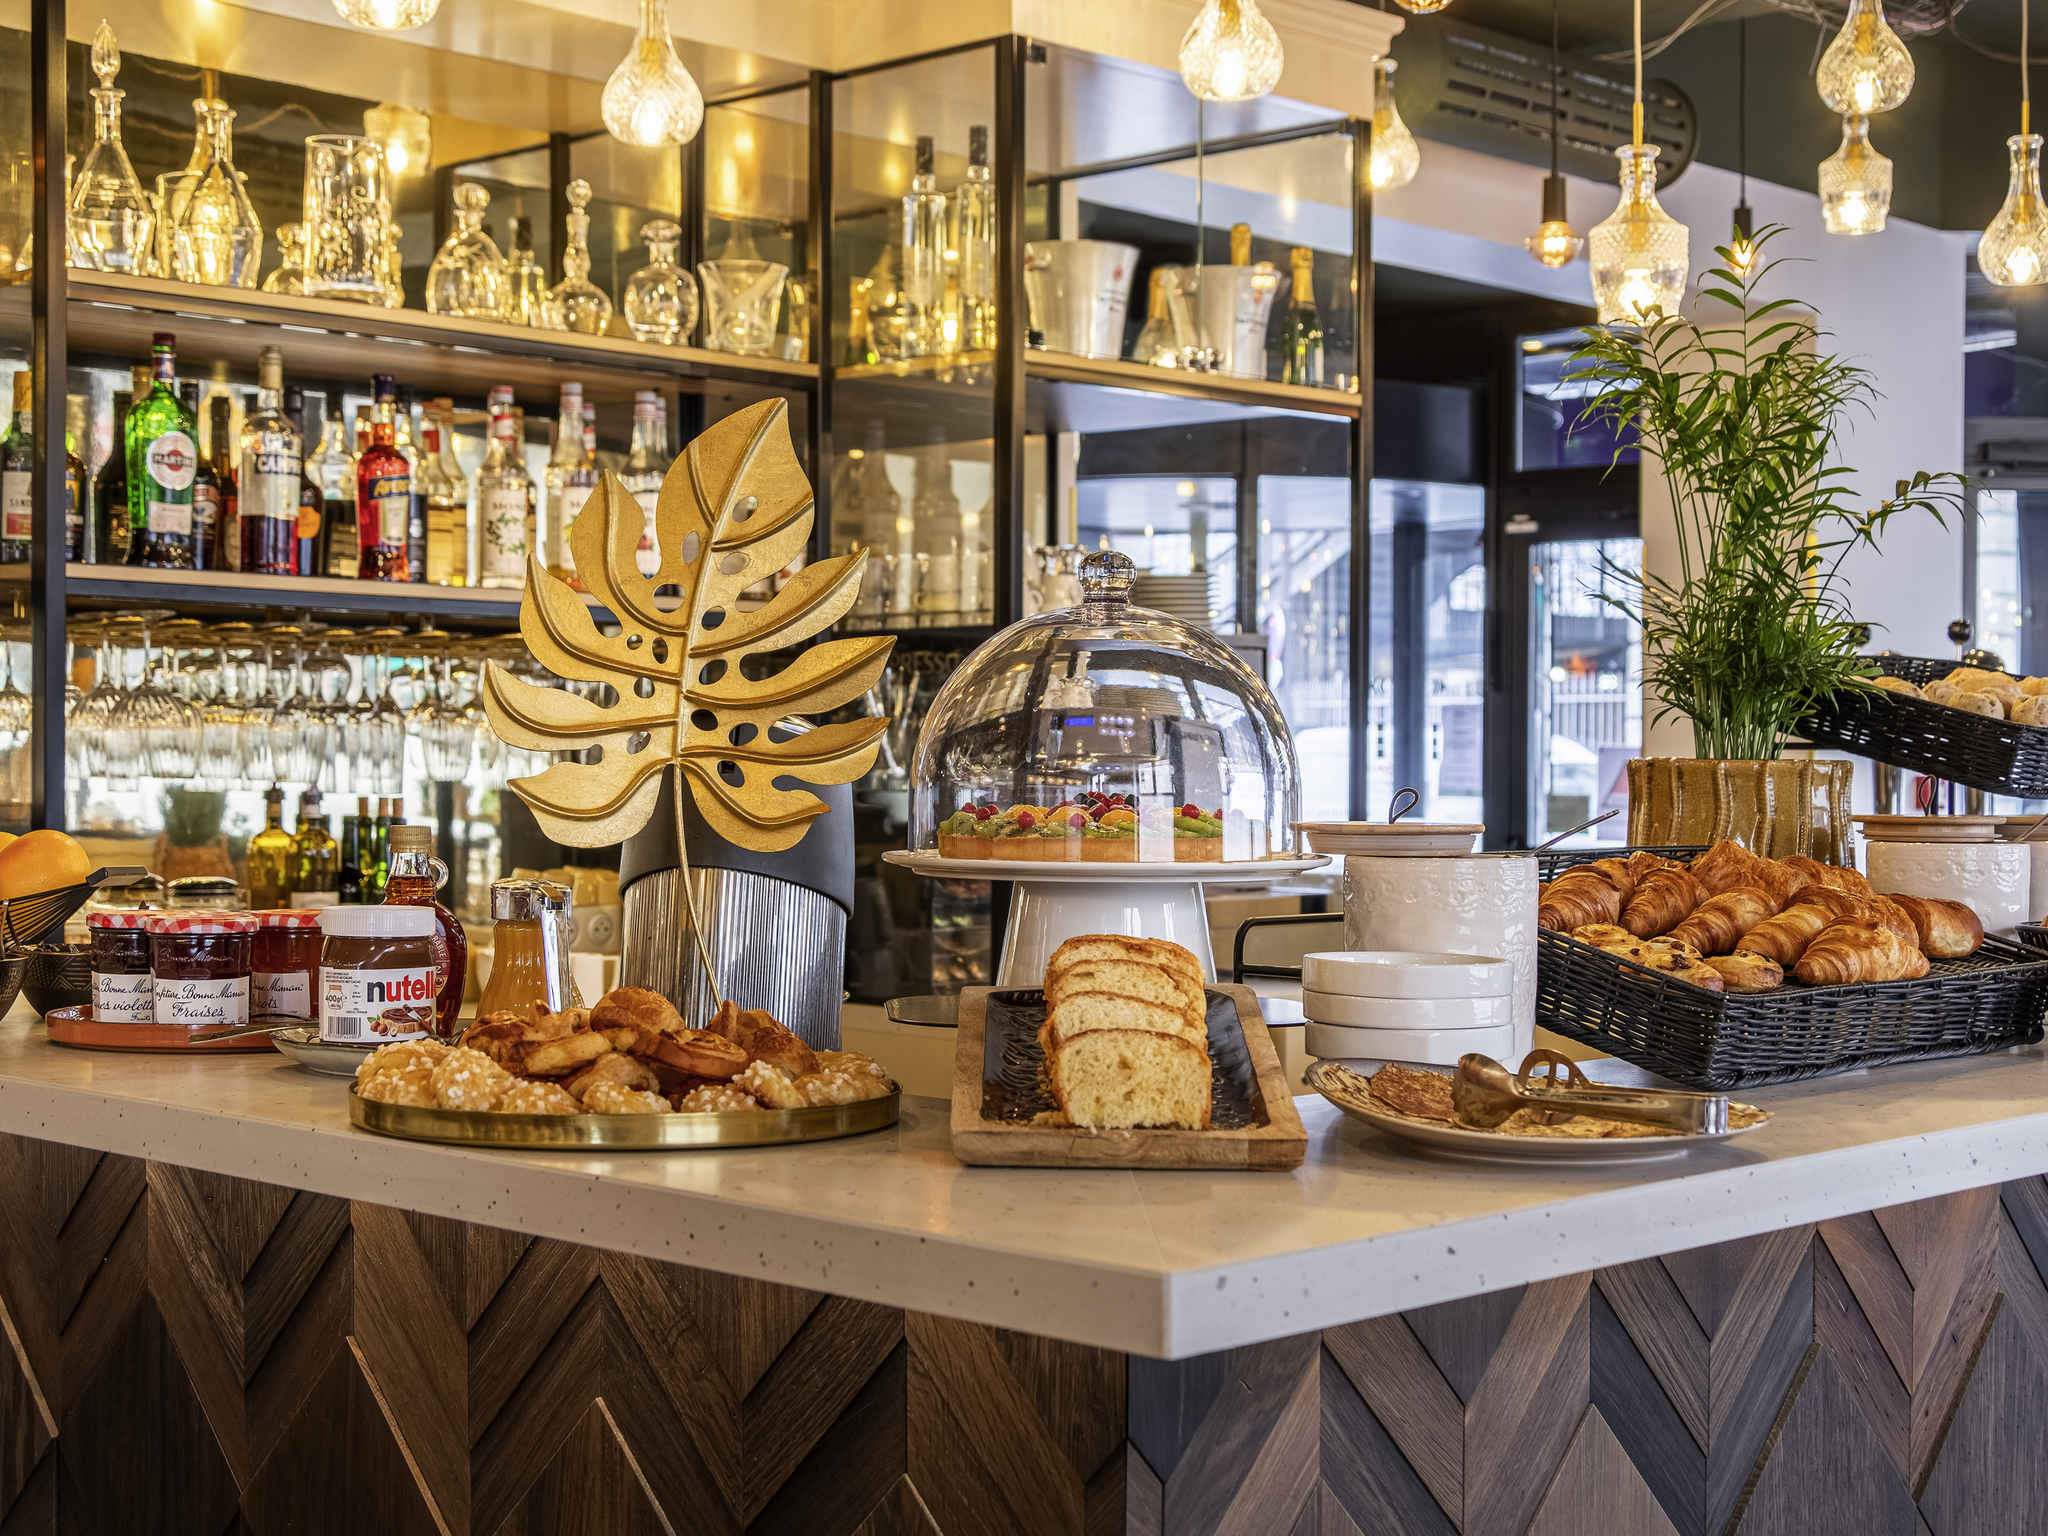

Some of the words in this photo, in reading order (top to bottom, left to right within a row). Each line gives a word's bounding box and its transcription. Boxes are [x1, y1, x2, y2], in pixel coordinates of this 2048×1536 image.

[432, 935, 447, 959] RABLE
[101, 976, 128, 993] Bonne
[128, 977, 153, 993] Mam
[155, 983, 180, 1001] nfiture
[181, 983, 215, 1000] Bonne
[367, 970, 435, 1003] nutell
[113, 998, 154, 1011] violett
[172, 1001, 225, 1018] Fraises
